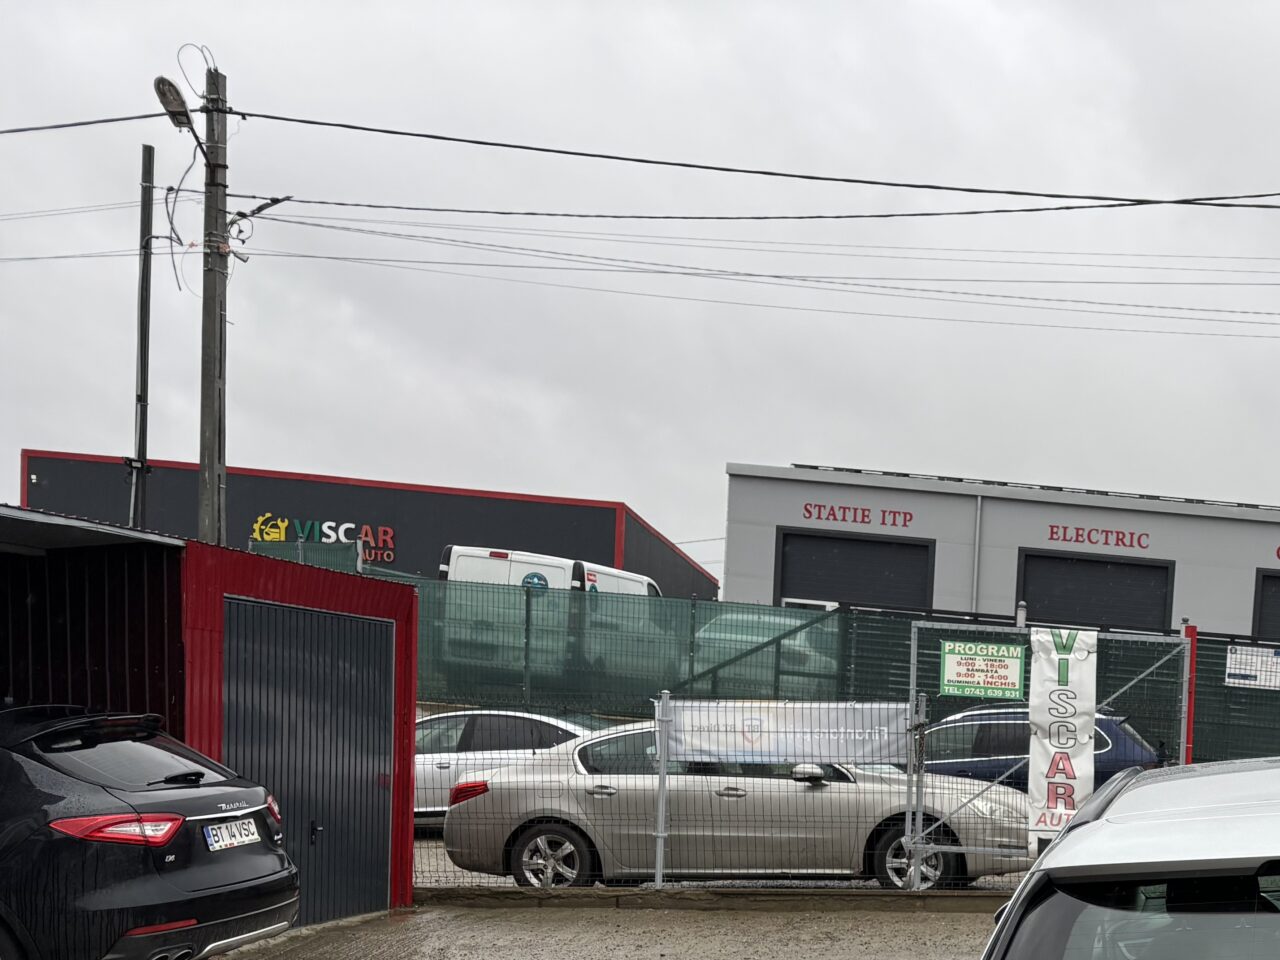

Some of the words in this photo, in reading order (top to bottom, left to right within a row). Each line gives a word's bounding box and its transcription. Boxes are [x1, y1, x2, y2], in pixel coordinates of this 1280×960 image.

[803, 503, 872, 524] STATIE
[880, 509, 914, 528] ITP
[293, 519, 394, 548] VISCAR
[1048, 524, 1150, 549] ELECTRIC
[944, 642, 1022, 658] PROGRAM
[944, 686, 962, 694] TEL:
[964, 688, 985, 696] 0743
[987, 689, 1002, 697] 639
[1005, 690, 1020, 698] 931
[1045, 629, 1077, 811] VISCAR
[210, 826, 225, 843] BT
[225, 823, 237, 841] 14
[235, 820, 255, 839] VSC
